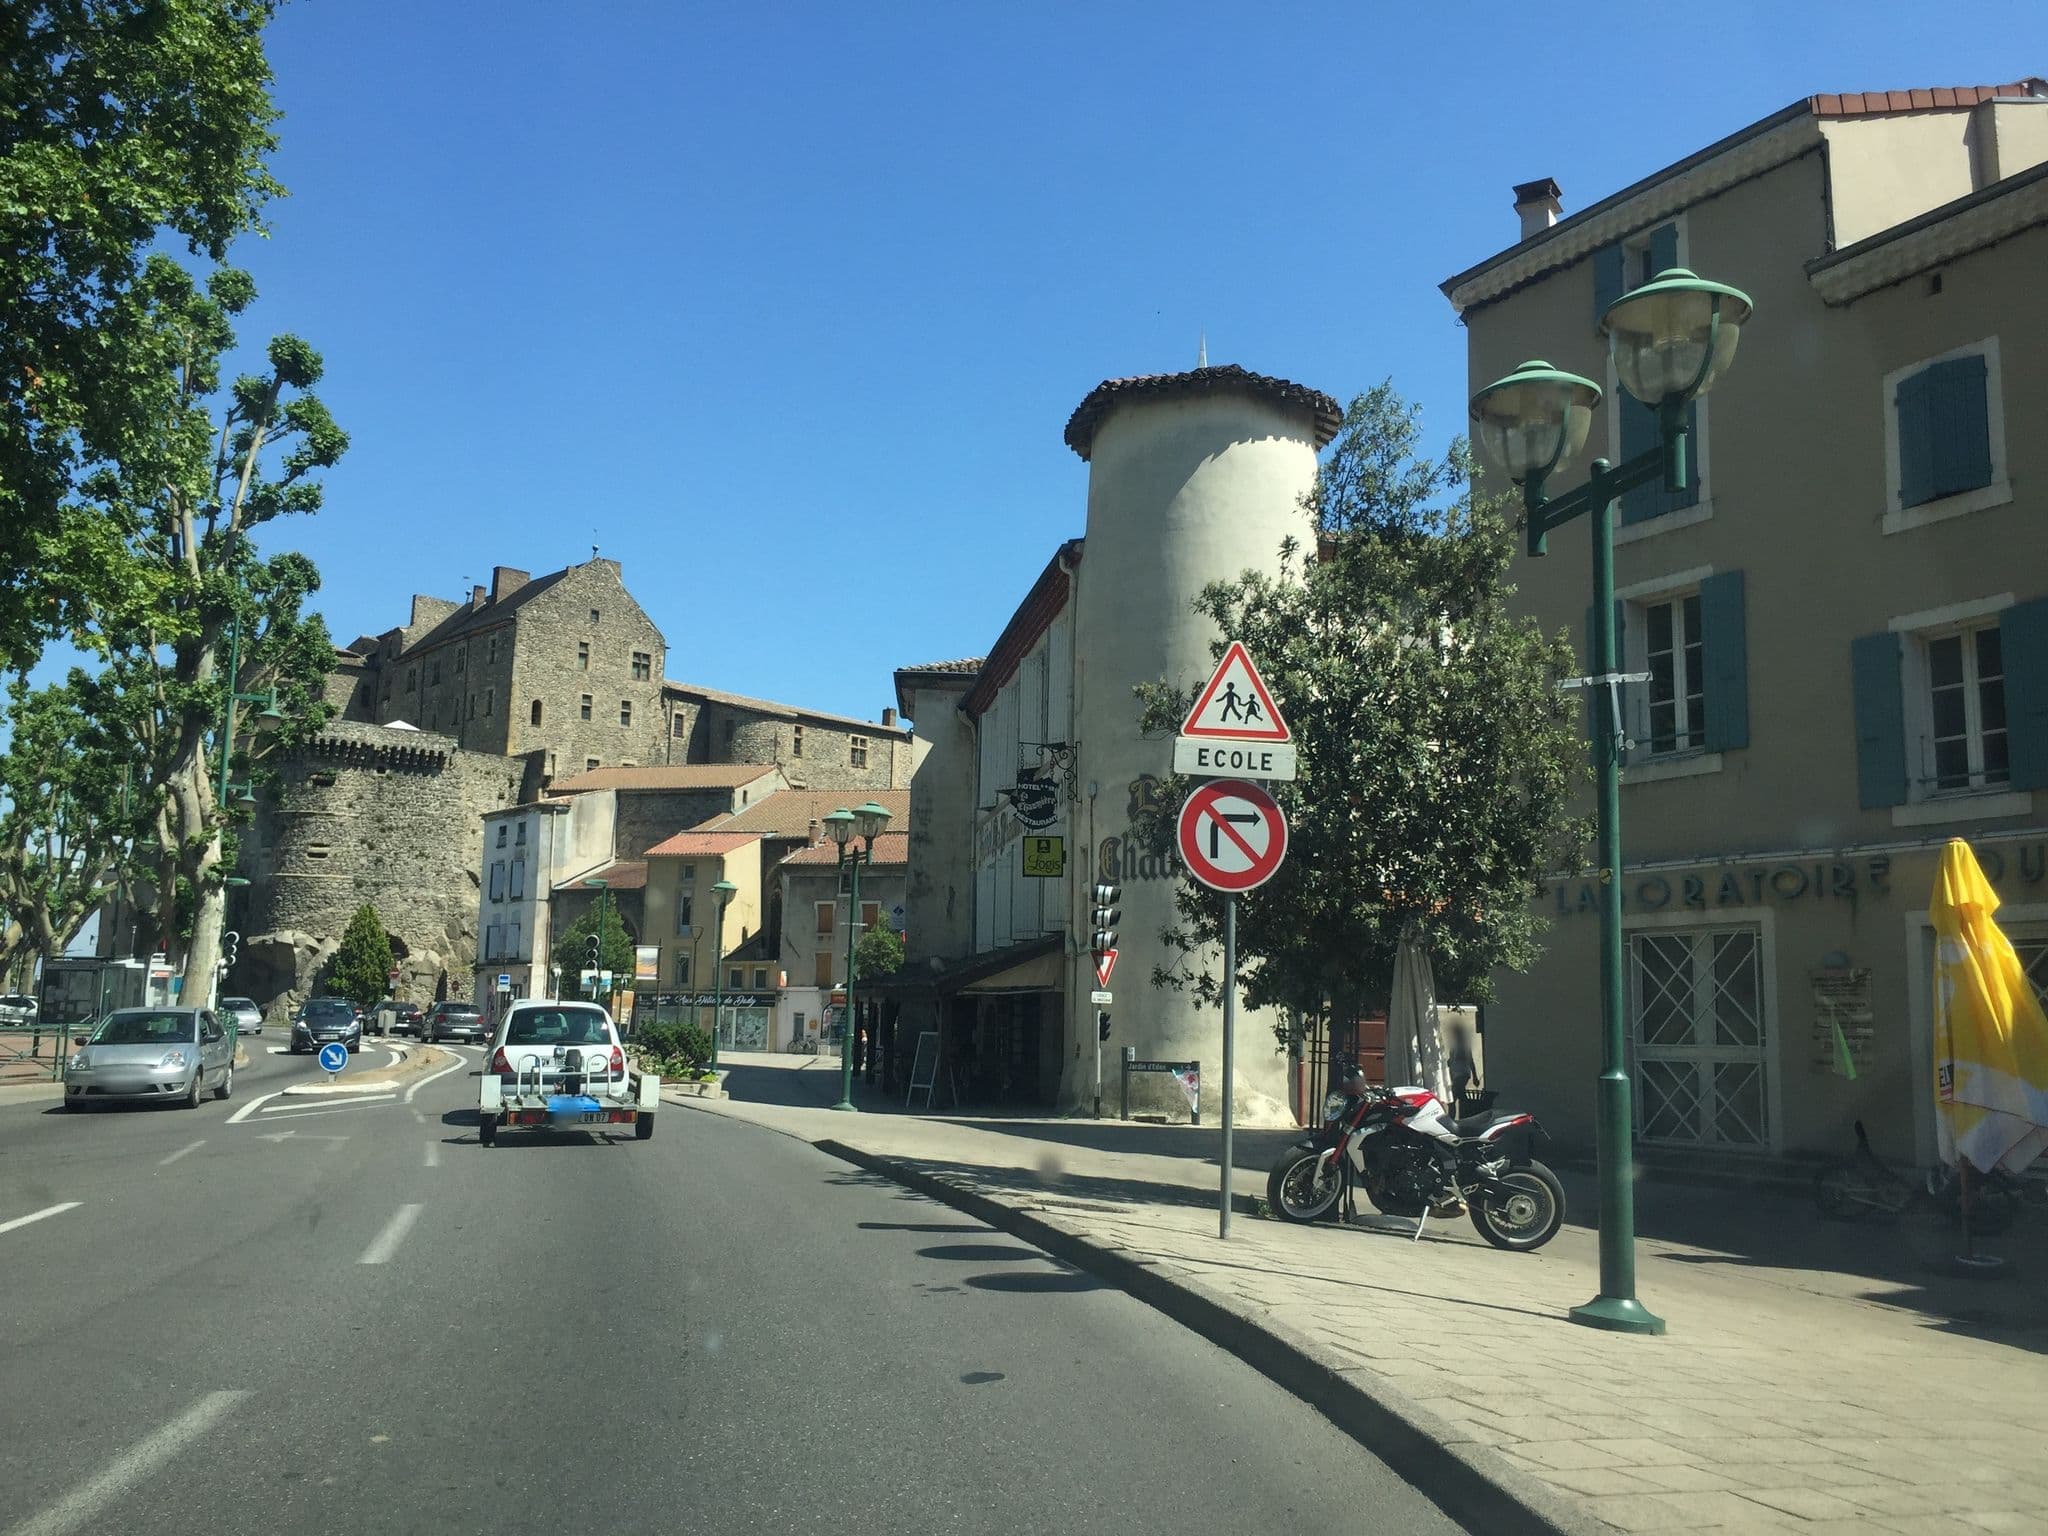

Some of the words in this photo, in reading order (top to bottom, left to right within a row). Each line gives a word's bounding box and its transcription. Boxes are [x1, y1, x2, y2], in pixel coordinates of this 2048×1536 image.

[1197, 747, 1274, 772] ECOLE
[1014, 811, 1059, 827] RESTAURANT
[1026, 854, 1061, 874] Logis
[1554, 854, 1891, 914] LAORATOIRE
